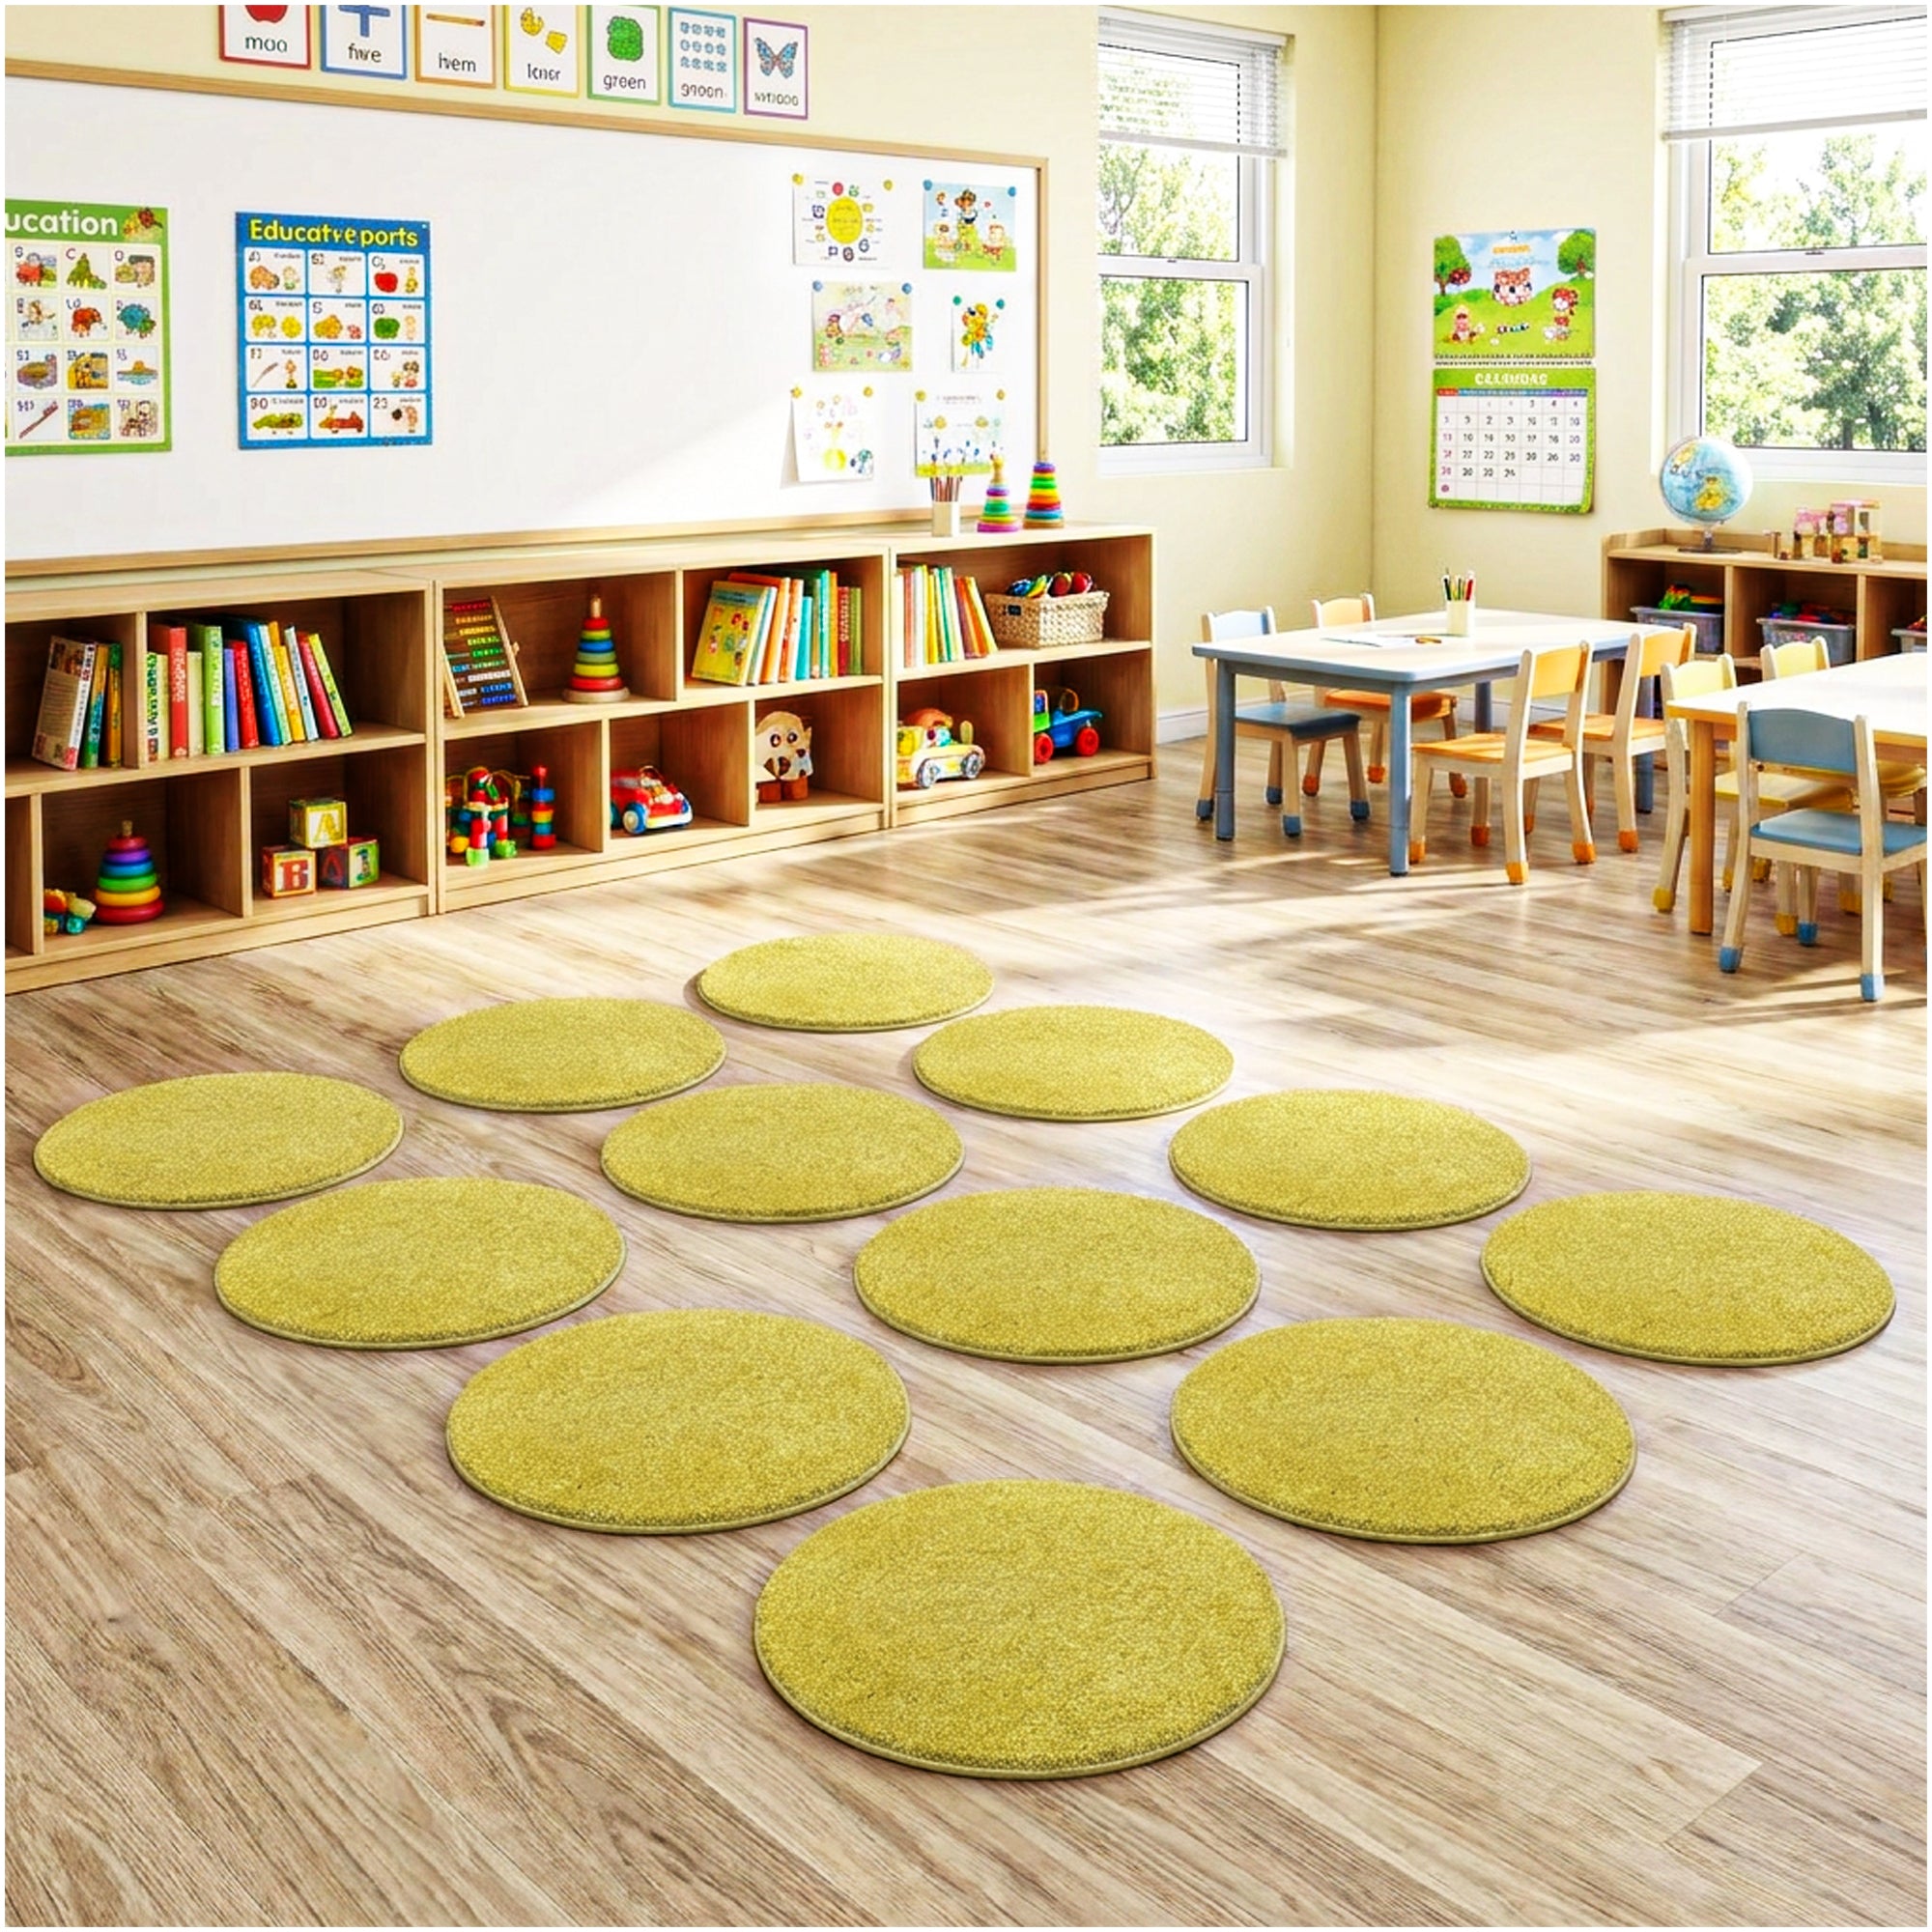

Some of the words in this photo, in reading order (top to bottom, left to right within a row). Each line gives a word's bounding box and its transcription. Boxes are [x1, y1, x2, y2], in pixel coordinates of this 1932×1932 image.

[603, 74, 646, 91] green
[360, 228, 418, 248] ports
[313, 812, 341, 842] A
